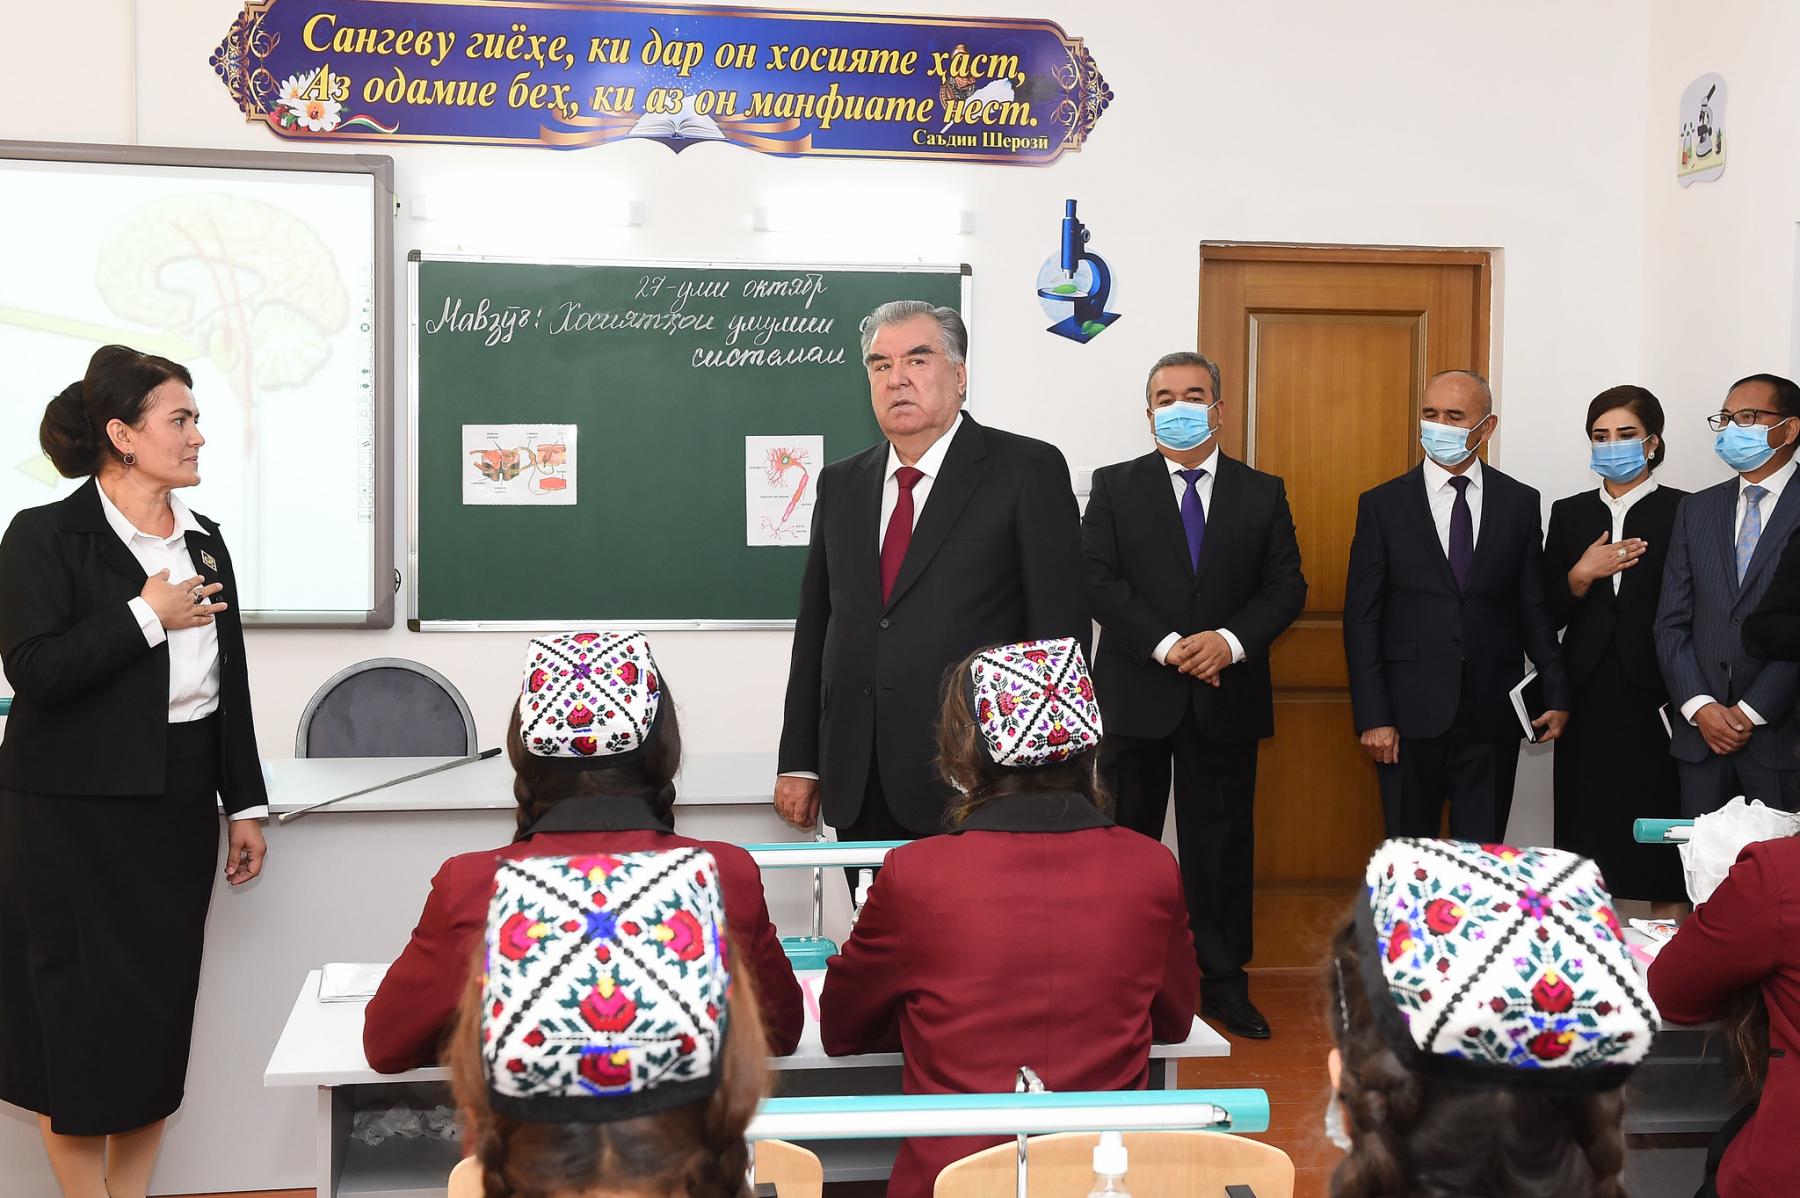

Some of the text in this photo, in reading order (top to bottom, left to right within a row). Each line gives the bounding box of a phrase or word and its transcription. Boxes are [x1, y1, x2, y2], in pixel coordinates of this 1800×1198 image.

[302, 13, 1027, 87] Сангеву гиёҳе, ки дар он хосияте ҳаст,
[300, 65, 1040, 129] Аз одамие беҳ, ки аз он манфиате нест.
[912, 129, 1049, 151] Саъдии Шерозӣ
[742, 273, 828, 309] октябр
